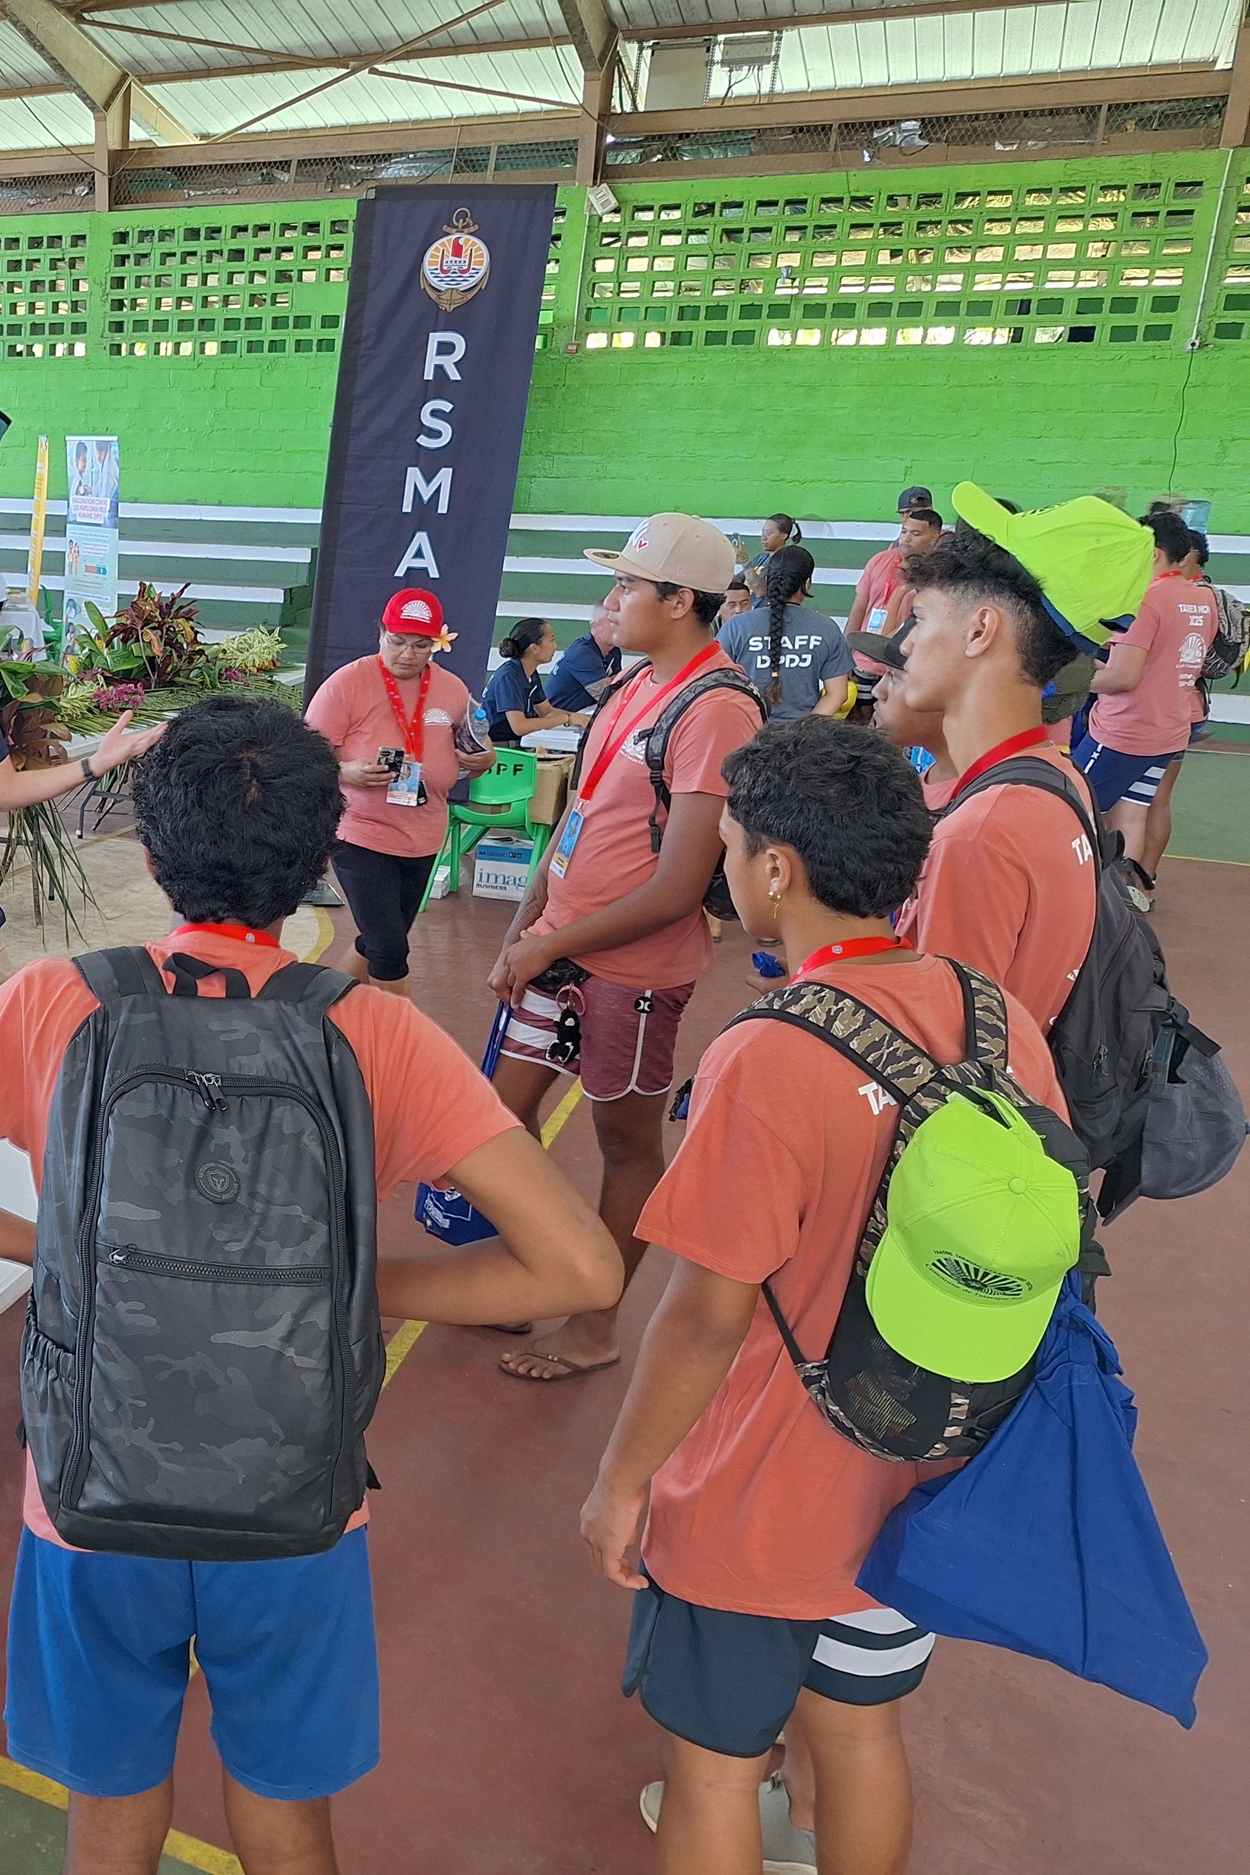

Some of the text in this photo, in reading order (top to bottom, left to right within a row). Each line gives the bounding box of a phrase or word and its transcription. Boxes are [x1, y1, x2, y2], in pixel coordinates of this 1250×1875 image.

[393, 331, 466, 579] RSMA
[748, 635, 823, 651] STAFF
[476, 882, 507, 891] BUSINESS
[478, 868, 527, 892] imag
